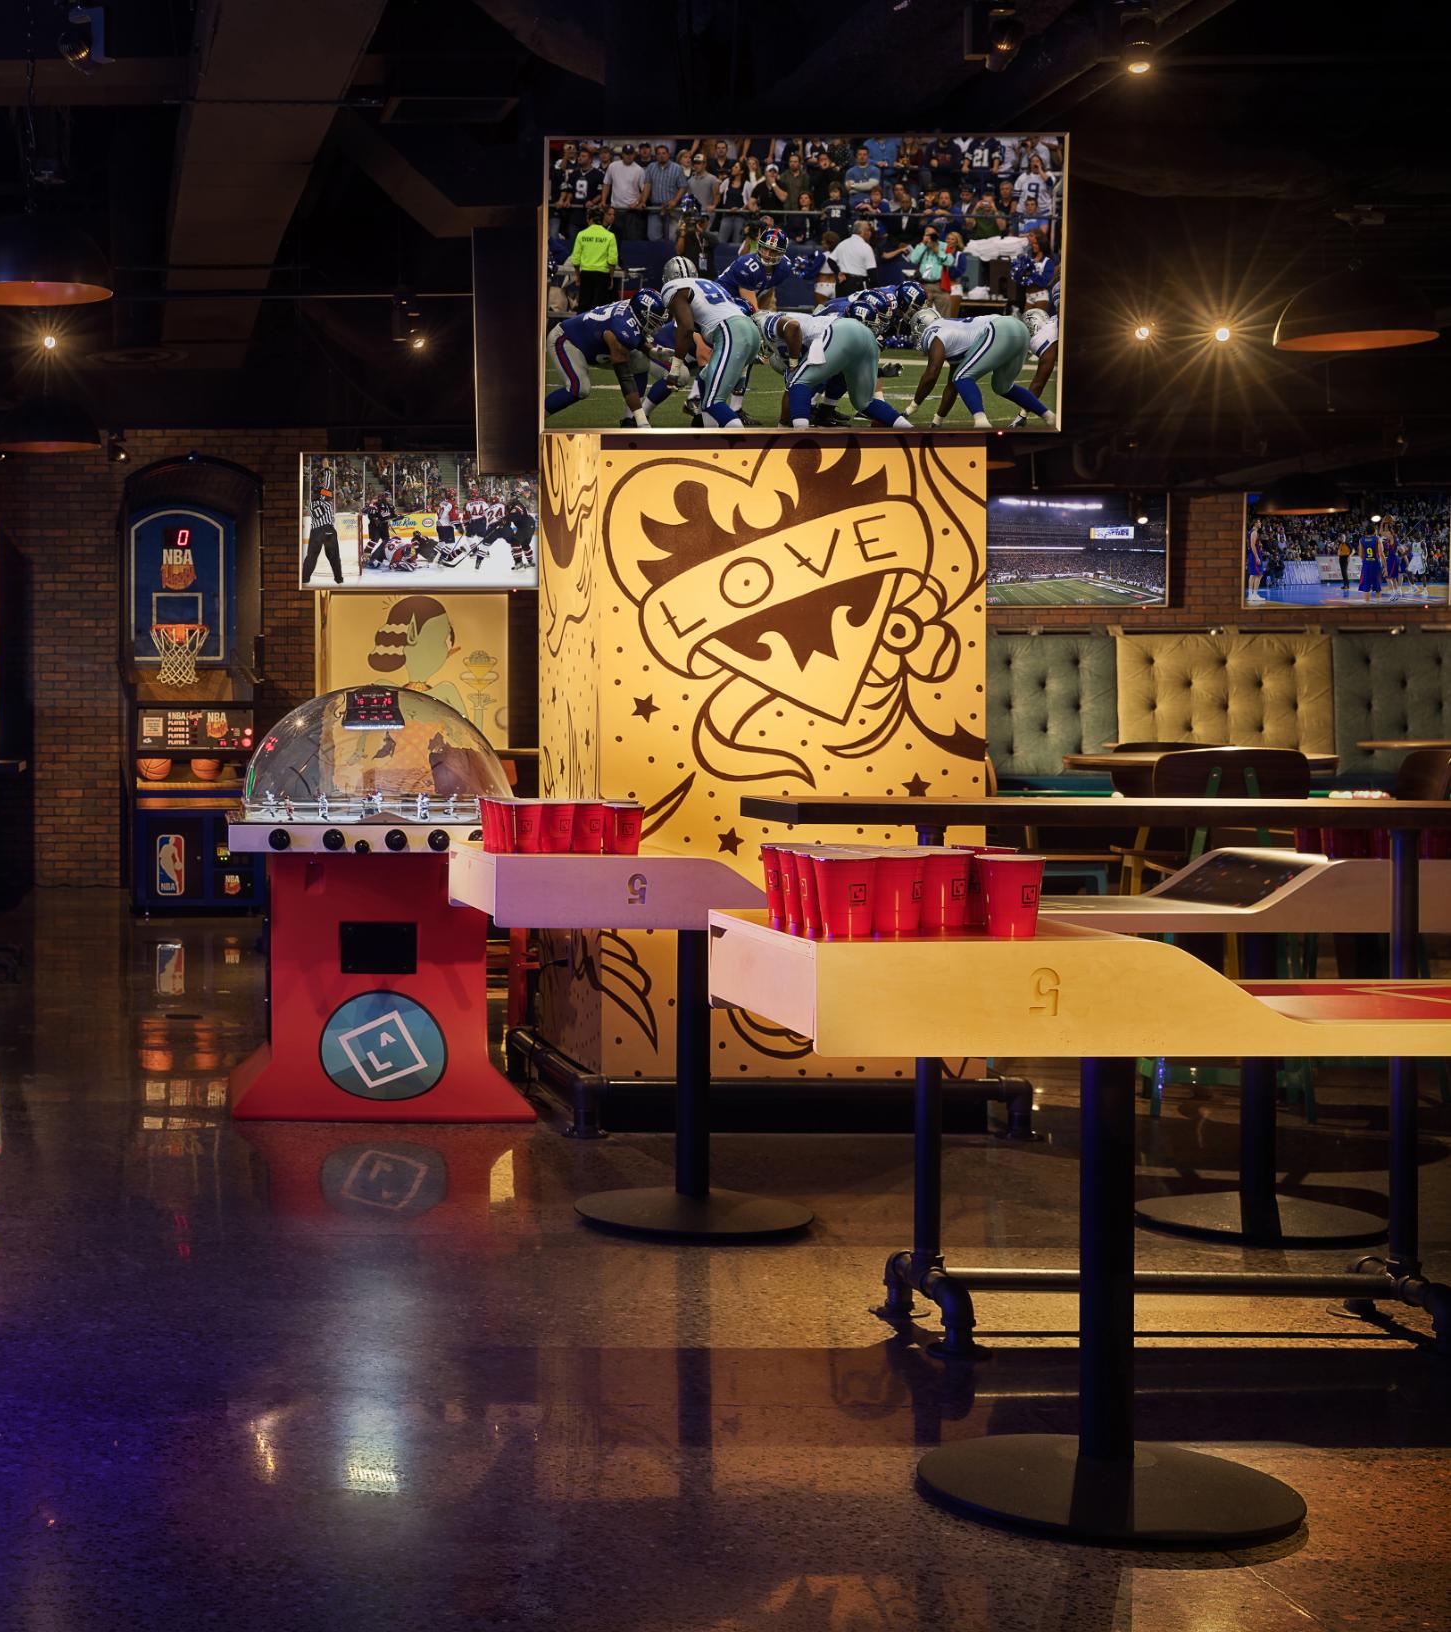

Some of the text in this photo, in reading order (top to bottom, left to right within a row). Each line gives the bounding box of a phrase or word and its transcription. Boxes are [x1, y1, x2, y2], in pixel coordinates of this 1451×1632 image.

[972, 148, 990, 168] 21
[574, 179, 588, 199] 9
[744, 258, 760, 273] 10
[472, 505, 484, 516] 44
[486, 506, 503, 521] 24
[177, 529, 190, 546] 0
[162, 548, 194, 565] NBA
[1366, 547, 1373, 558] 9
[659, 514, 898, 640] LOVE
[207, 712, 227, 723] NBA
[160, 882, 176, 891] NBA
[225, 875, 241, 884] NBA
